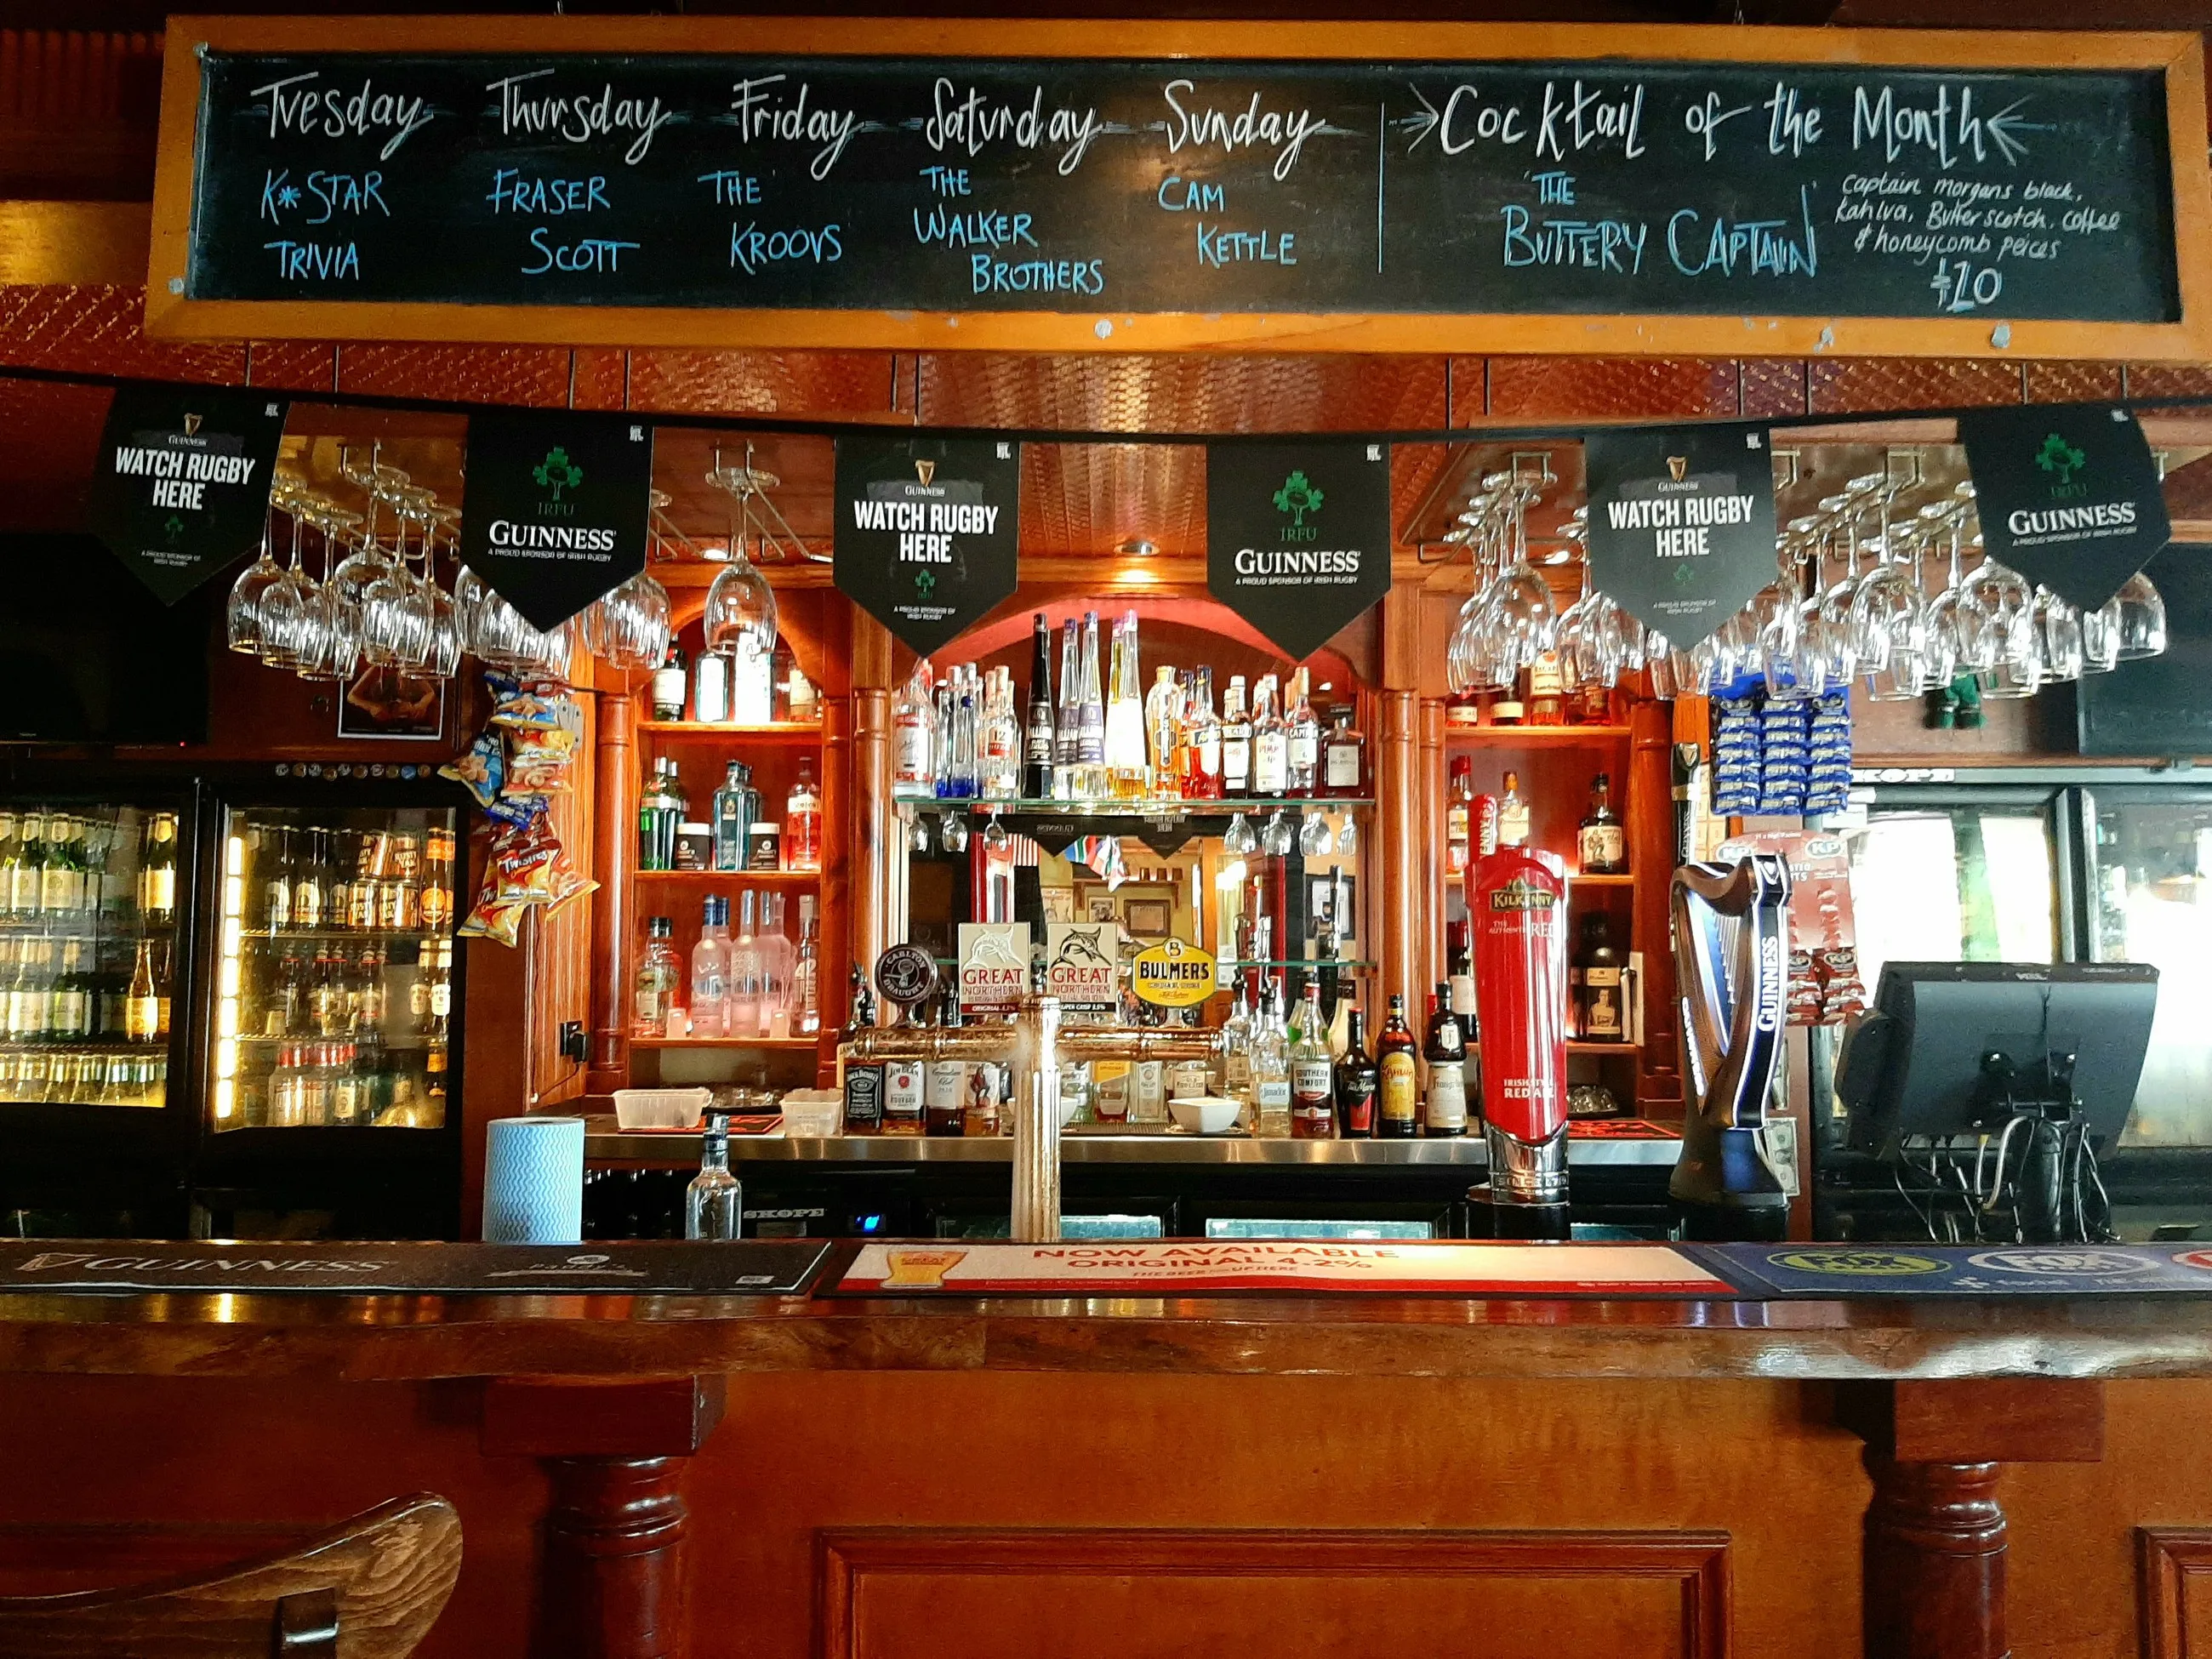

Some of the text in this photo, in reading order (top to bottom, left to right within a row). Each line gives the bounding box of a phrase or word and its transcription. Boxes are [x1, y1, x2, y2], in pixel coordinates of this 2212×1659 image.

[251, 71, 433, 160] Tuesday
[487, 68, 671, 164] Thursday
[732, 74, 864, 180] Friday
[927, 77, 1106, 175] Saturday
[1164, 78, 1324, 180] Sunday
[1685, 89, 1753, 162] of
[1764, 81, 1823, 153] the
[1854, 83, 1987, 169] Month
[486, 168, 611, 214] FRASER
[698, 170, 761, 207] THE
[920, 165, 972, 196] THE
[1158, 176, 1225, 213] CAM
[1532, 170, 1575, 206] THE
[913, 208, 1039, 249] WALKER
[1196, 222, 1298, 268] KETTLE
[1501, 184, 1816, 279] BUTTERY CAPTAIN
[264, 242, 360, 280] TRIVIA
[521, 227, 641, 274] SCOTT
[972, 254, 1104, 295] BROTHERS
[116, 446, 255, 486] WATCH RUGBY
[152, 479, 206, 510] HERE
[1607, 494, 1755, 530] WATCH RUGBY
[853, 500, 999, 535] WATCH RUGBY
[2008, 500, 2136, 536] GUINNESS
[489, 520, 616, 551] GUINNESS
[899, 533, 953, 563] HERE
[1656, 527, 1711, 558] HERE
[1234, 548, 1360, 574] GUINNESS
[1494, 894, 1552, 908] KILKNNY
[886, 950, 926, 968] CARLTON
[1170, 942, 1181, 957] B
[963, 968, 1024, 985] GREAT
[1051, 967, 1113, 984] GREAT
[1140, 961, 1210, 980] BULMERS
[1757, 935, 1778, 1032] GUINNESS
[883, 981, 924, 996] DRAUGHT
[963, 985, 1023, 995] NORTHERN
[1052, 984, 1110, 995] NORTHERN
[1504, 1087, 1531, 1098] RED
[743, 1207, 825, 1218] SKOPE
[84, 1257, 391, 1272] GUINNESS
[1032, 1246, 1400, 1258] NOW AVAILABLE
[1068, 1257, 1373, 1268] ORIGINAL 4.2%
